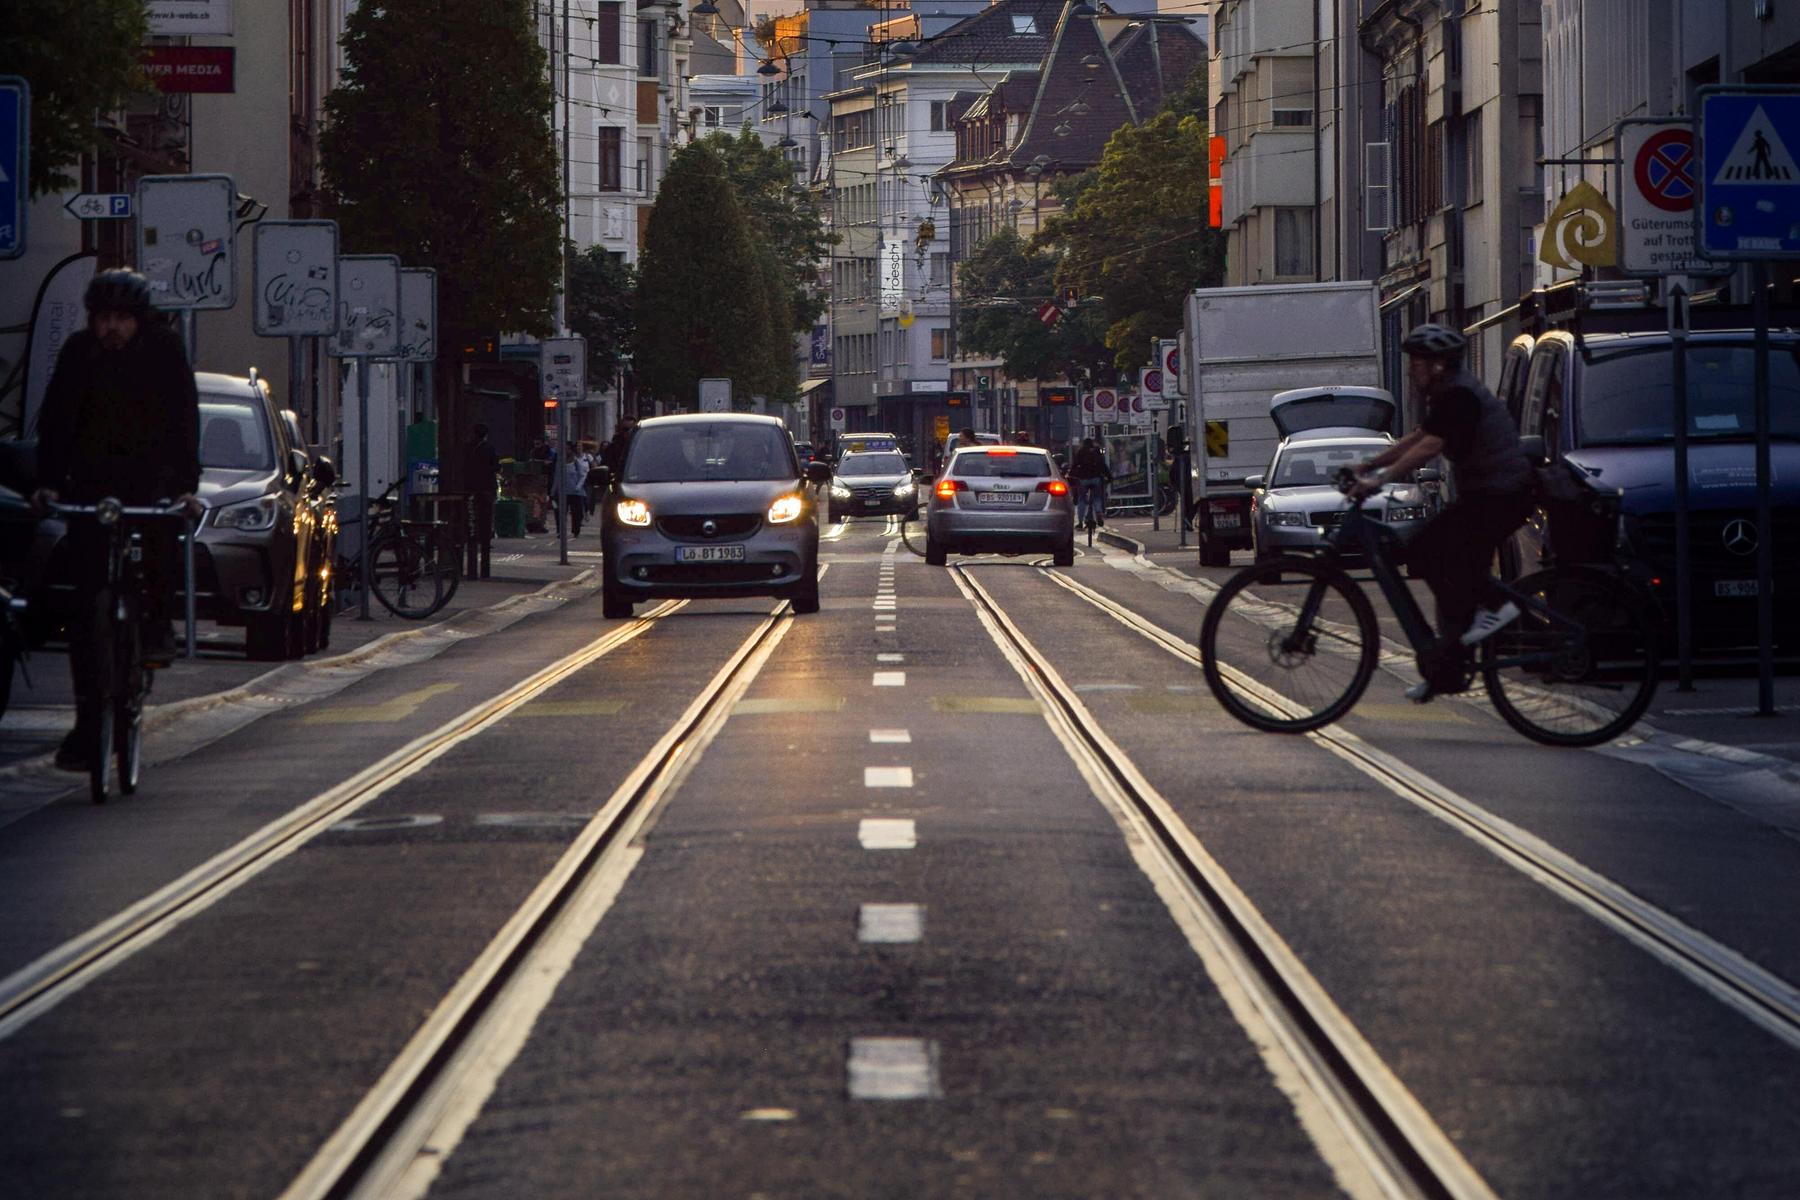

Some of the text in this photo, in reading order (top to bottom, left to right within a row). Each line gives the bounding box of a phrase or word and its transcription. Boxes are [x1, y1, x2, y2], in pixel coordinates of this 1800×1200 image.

[176, 64, 222, 76] MEDIA
[115, 198, 126, 213] P
[1643, 234, 1696, 246] auf Trott
[889, 244, 900, 290] roesch
